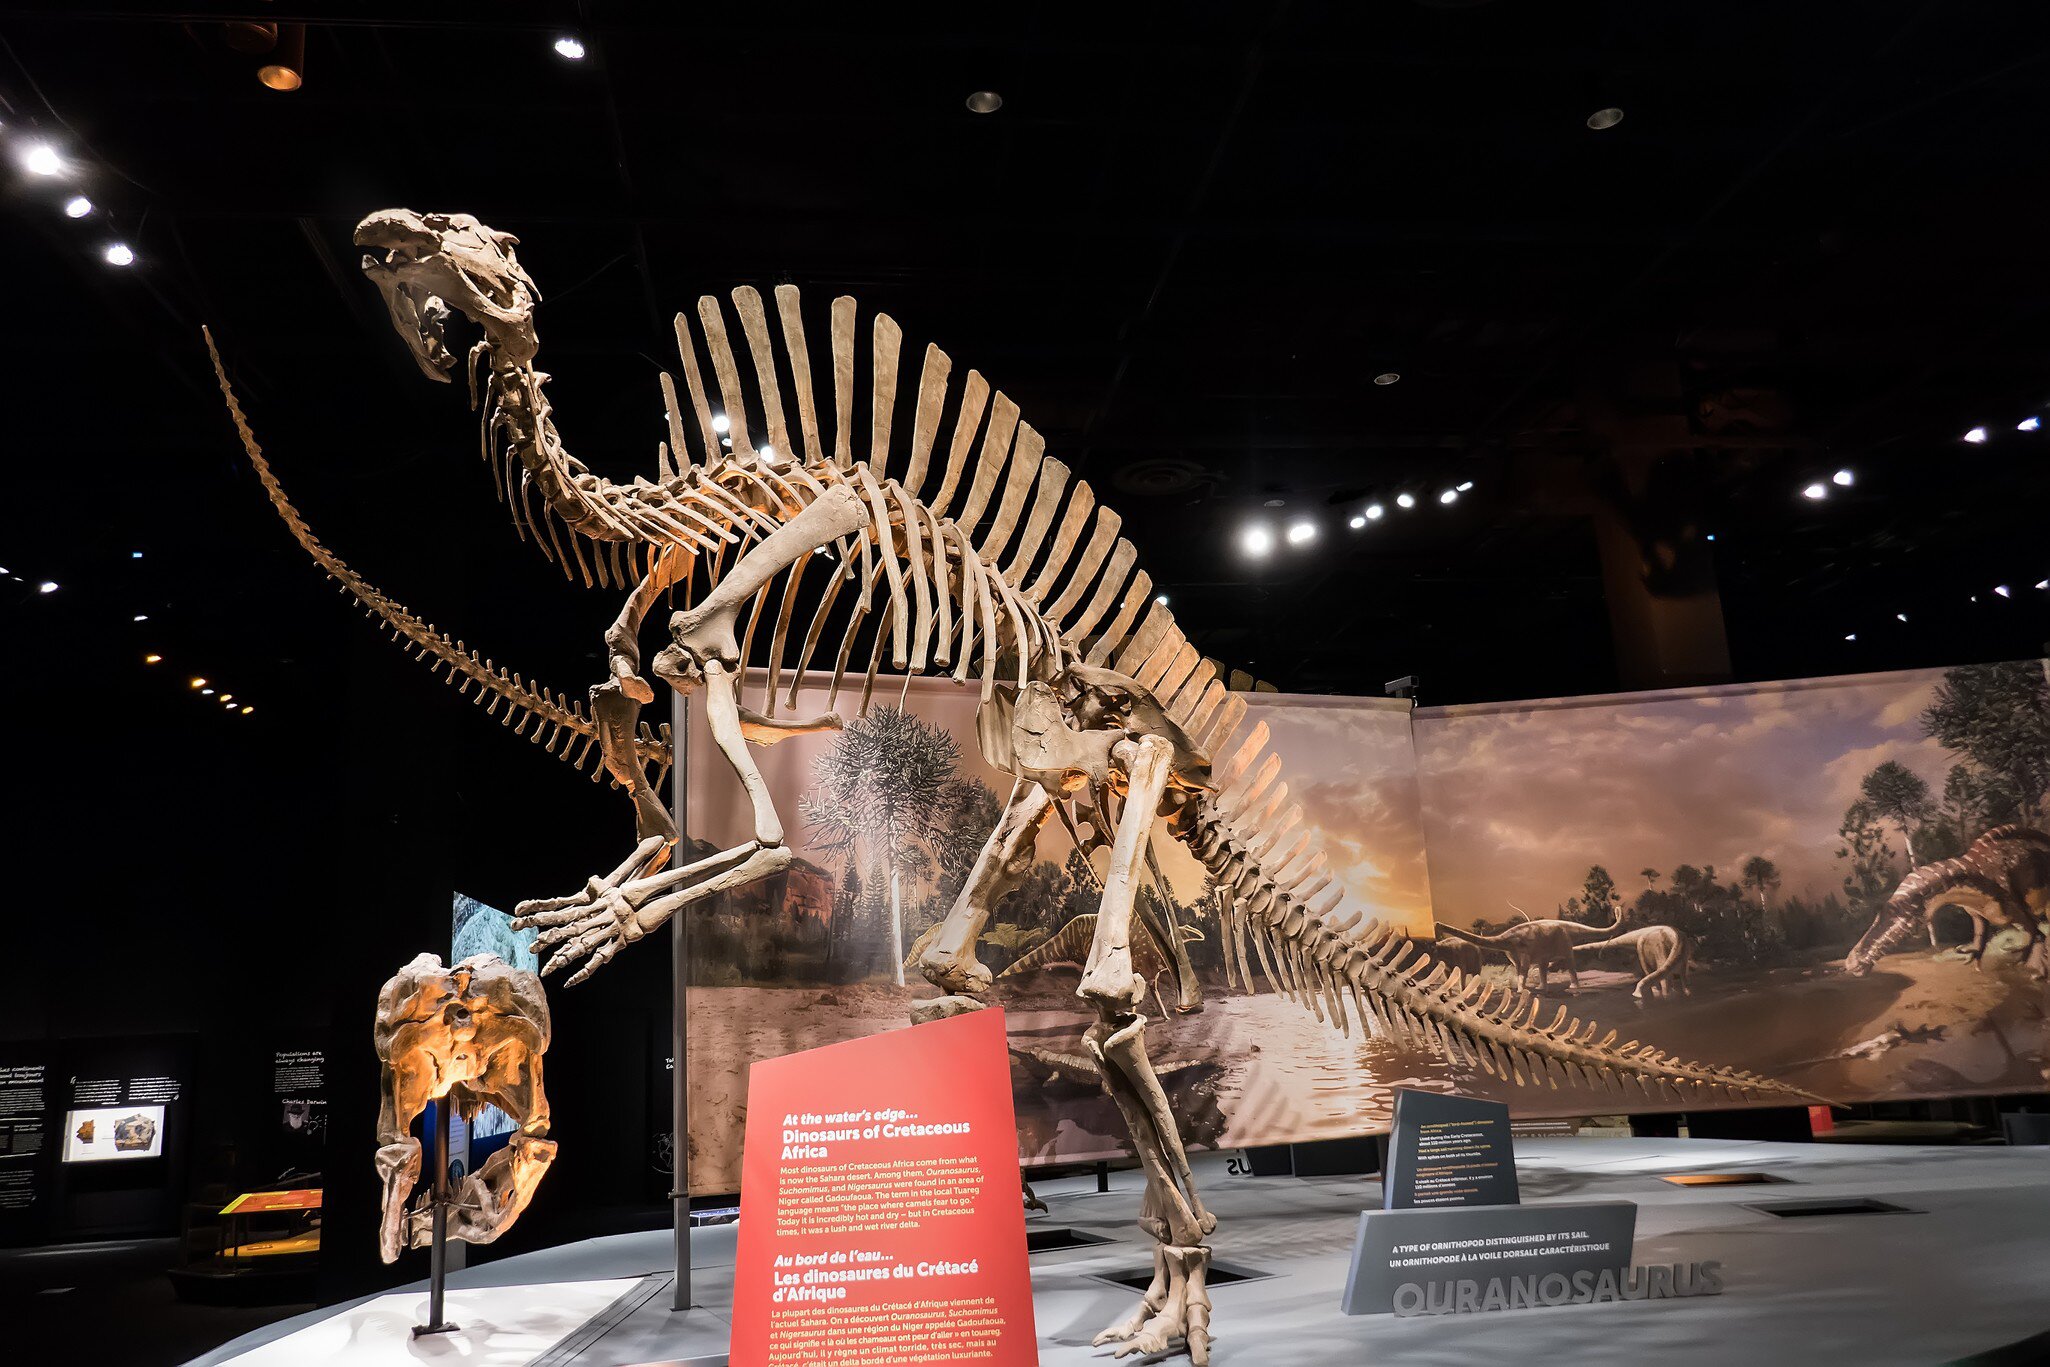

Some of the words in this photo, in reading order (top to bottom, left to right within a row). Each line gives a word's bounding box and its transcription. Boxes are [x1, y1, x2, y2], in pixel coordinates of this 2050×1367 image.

[783, 1114, 798, 1126] At
[801, 1113, 822, 1125] the
[825, 1110, 872, 1124] water's
[874, 1108, 918, 1122] edge...
[783, 1128, 860, 1143] Dinosaurs
[863, 1125, 880, 1139] of
[883, 1122, 970, 1138] Cretaceous
[782, 1145, 828, 1160] Africa
[780, 1166, 799, 1174] Most
[800, 1165, 837, 1173] dinosaurs
[838, 1163, 847, 1171] of
[848, 1162, 891, 1170] Cretaceous
[892, 1159, 914, 1167] Africa
[938, 1157, 957, 1165] from
[958, 1155, 977, 1163] what
[780, 1177, 786, 1185] is
[805, 1175, 818, 1183] the
[820, 1174, 845, 1182] Sahara
[874, 1171, 901, 1179] Among
[832, 1183, 846, 1192] and
[847, 1182, 892, 1192] Nigersaurus
[914, 1178, 937, 1187] found
[976, 1175, 984, 1183] of
[778, 1197, 799, 1206] Niger
[800, 1195, 824, 1203] called
[875, 1191, 890, 1199] The
[891, 1190, 909, 1198] term
[910, 1189, 918, 1197] in
[920, 1188, 932, 1196] the
[934, 1187, 952, 1195] local
[954, 1186, 979, 1195] Tuareg
[777, 1207, 813, 1216] language
[858, 1203, 879, 1212] place
[880, 1201, 904, 1209] where
[905, 1199, 932, 1207] camels
[933, 1198, 948, 1206] fear
[950, 1197, 958, 1205] to
[778, 1217, 800, 1226] Today
[802, 1216, 807, 1224] it
[808, 1216, 815, 1224] is
[816, 1214, 854, 1223] incredibly
[855, 1213, 869, 1221] hot
[870, 1212, 885, 1220] and
[886, 1211, 899, 1220] dry
[908, 1210, 921, 1218] but
[922, 1209, 930, 1217] in
[932, 1208, 974, 1216] Cretaceous
[830, 1224, 847, 1232] lush
[848, 1223, 863, 1231] and
[864, 1222, 879, 1230] wet
[1400, 1245, 1418, 1253] TYPE
[1432, 1239, 1484, 1250] ORNITHOPOD
[1486, 1234, 1545, 1246] DISTINGUISHED
[1546, 1233, 1557, 1241] BY
[1558, 1232, 1570, 1240] ITS
[1572, 1231, 1589, 1239] SAIL.
[774, 1255, 792, 1267] Au
[795, 1252, 828, 1266] bord
[830, 1251, 846, 1264] de
[849, 1250, 893, 1262] l'eau...
[1403, 1255, 1460, 1266] ORNITHOPODE
[1461, 1253, 1467, 1261] À
[1478, 1251, 1502, 1260] VOILE
[1503, 1249, 1538, 1258] DORSALE
[1539, 1243, 1610, 1255] CARACTÉRISTIQUE
[774, 1272, 800, 1286] Les
[803, 1268, 889, 1284] dinosaures
[893, 1264, 914, 1278] du
[917, 1259, 978, 1276] Crétacé
[773, 1286, 846, 1302] d'Afrique
[1392, 1261, 1724, 1317] OURANOSAURUS
[771, 1310, 780, 1318] La
[782, 1308, 810, 1319] plupart
[812, 1307, 825, 1315] des
[827, 1306, 869, 1314] dinosaures
[882, 1301, 912, 1311] Crétacé
[914, 1300, 948, 1309] d'Afrique
[950, 1296, 983, 1306] viennent
[985, 1296, 994, 1304] de
[770, 1319, 799, 1329] l'actuel
[850, 1313, 889, 1323] découvert
[948, 1307, 998, 1317] Suchomimus
[770, 1331, 778, 1339] et
[780, 1330, 826, 1340] Nigersaurus
[864, 1324, 889, 1334] région
[890, 1323, 901, 1331] du
[902, 1322, 923, 1332] Niger
[925, 1320, 955, 1331] appelée
[780, 1341, 792, 1351] qui
[793, 1339, 820, 1350] signifie
[827, 1338, 834, 1346] là
[835, 1337, 846, 1345] où
[846, 1337, 857, 1345] les
[858, 1335, 896, 1344] chameaux
[898, 1333, 911, 1341] ont
[912, 1333, 929, 1342] peur
[930, 1330, 953, 1339] d'aller
[820, 1349, 825, 1357] il
[827, 1351, 832, 1359] y
[834, 1348, 857, 1358] règne
[872, 1344, 897, 1354] climat
[931, 1341, 946, 1350] très
[966, 1339, 985, 1347] mais
